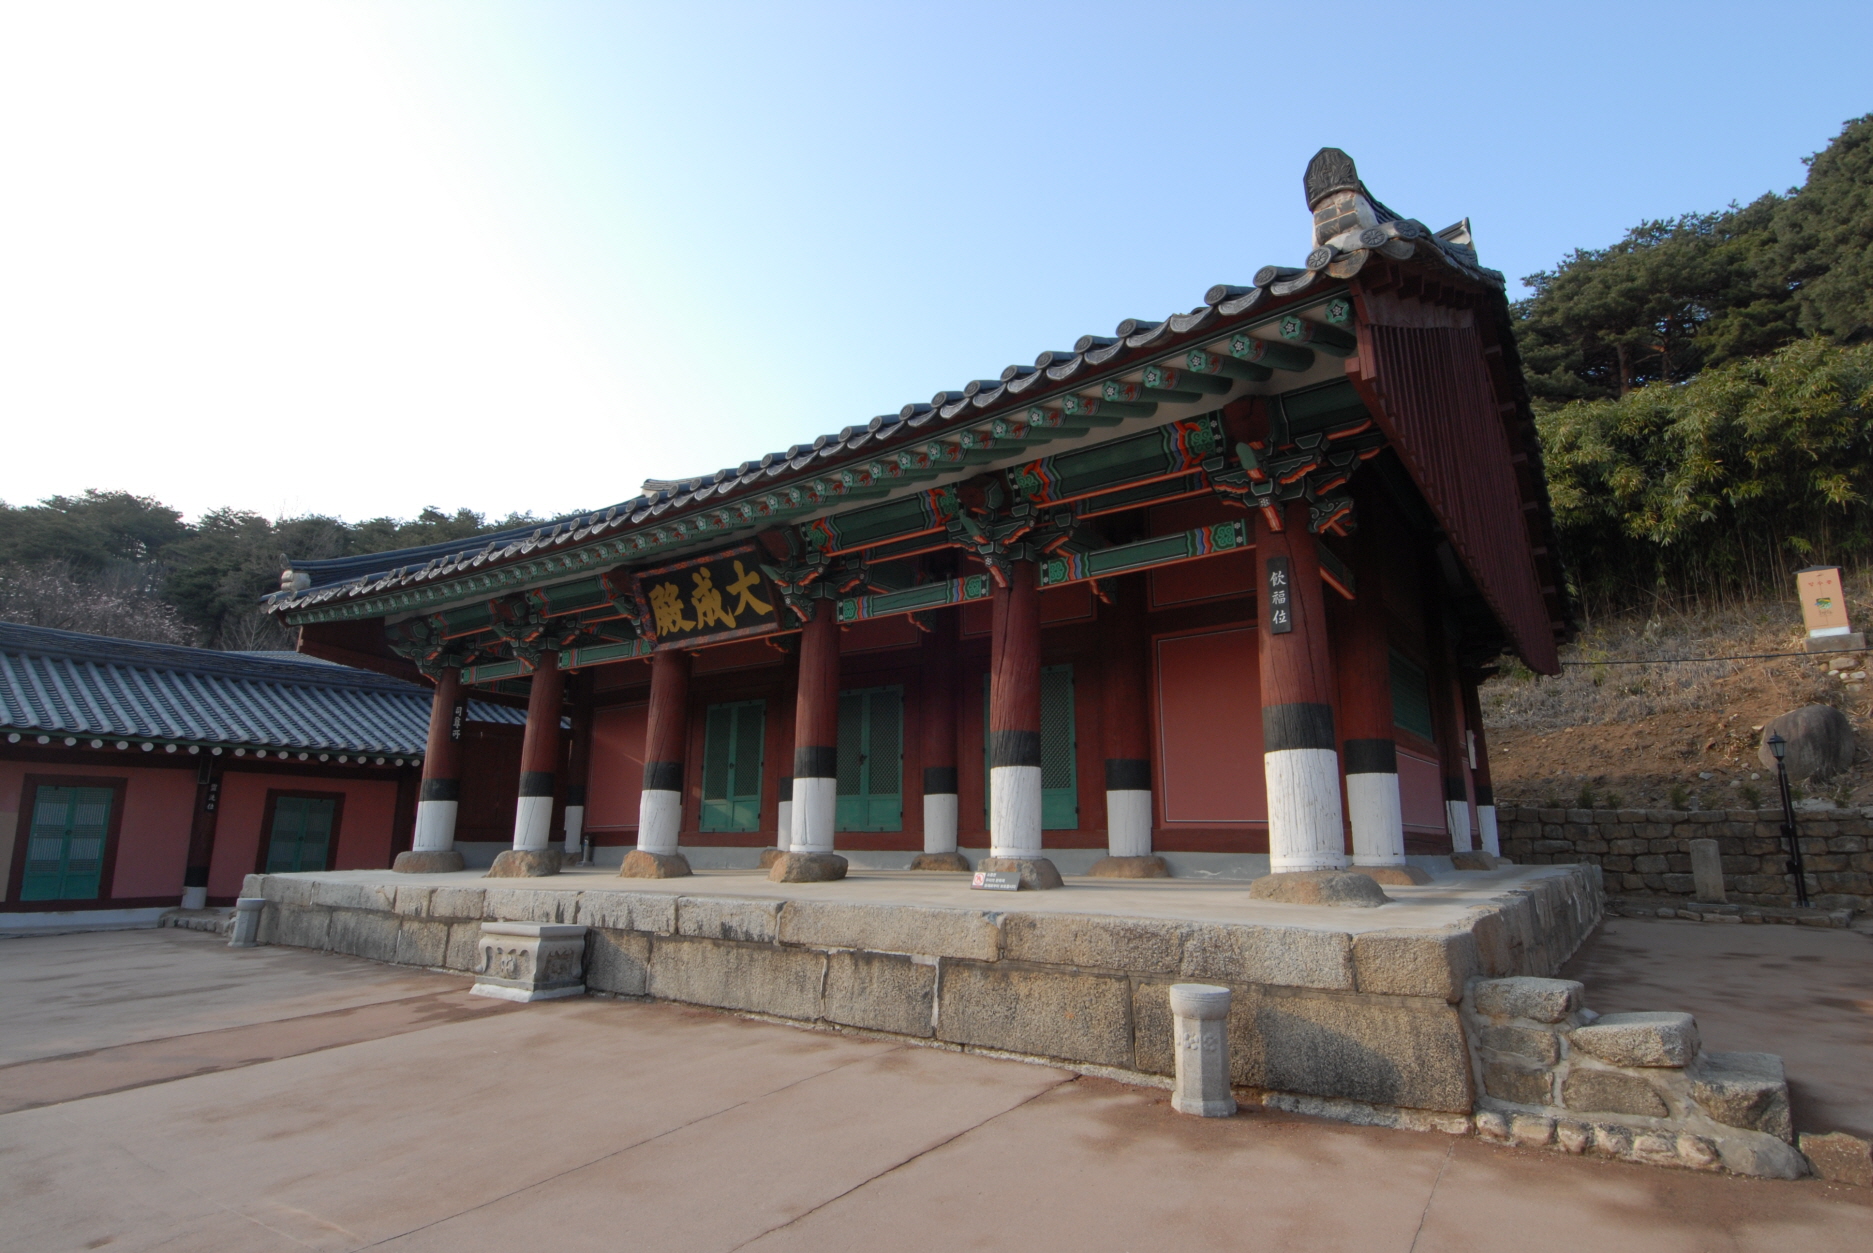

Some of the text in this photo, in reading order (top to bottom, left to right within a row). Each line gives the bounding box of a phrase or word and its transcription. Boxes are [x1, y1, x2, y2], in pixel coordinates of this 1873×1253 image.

[648, 560, 774, 637] 大成殿
[1270, 570, 1287, 624] 飲福位
